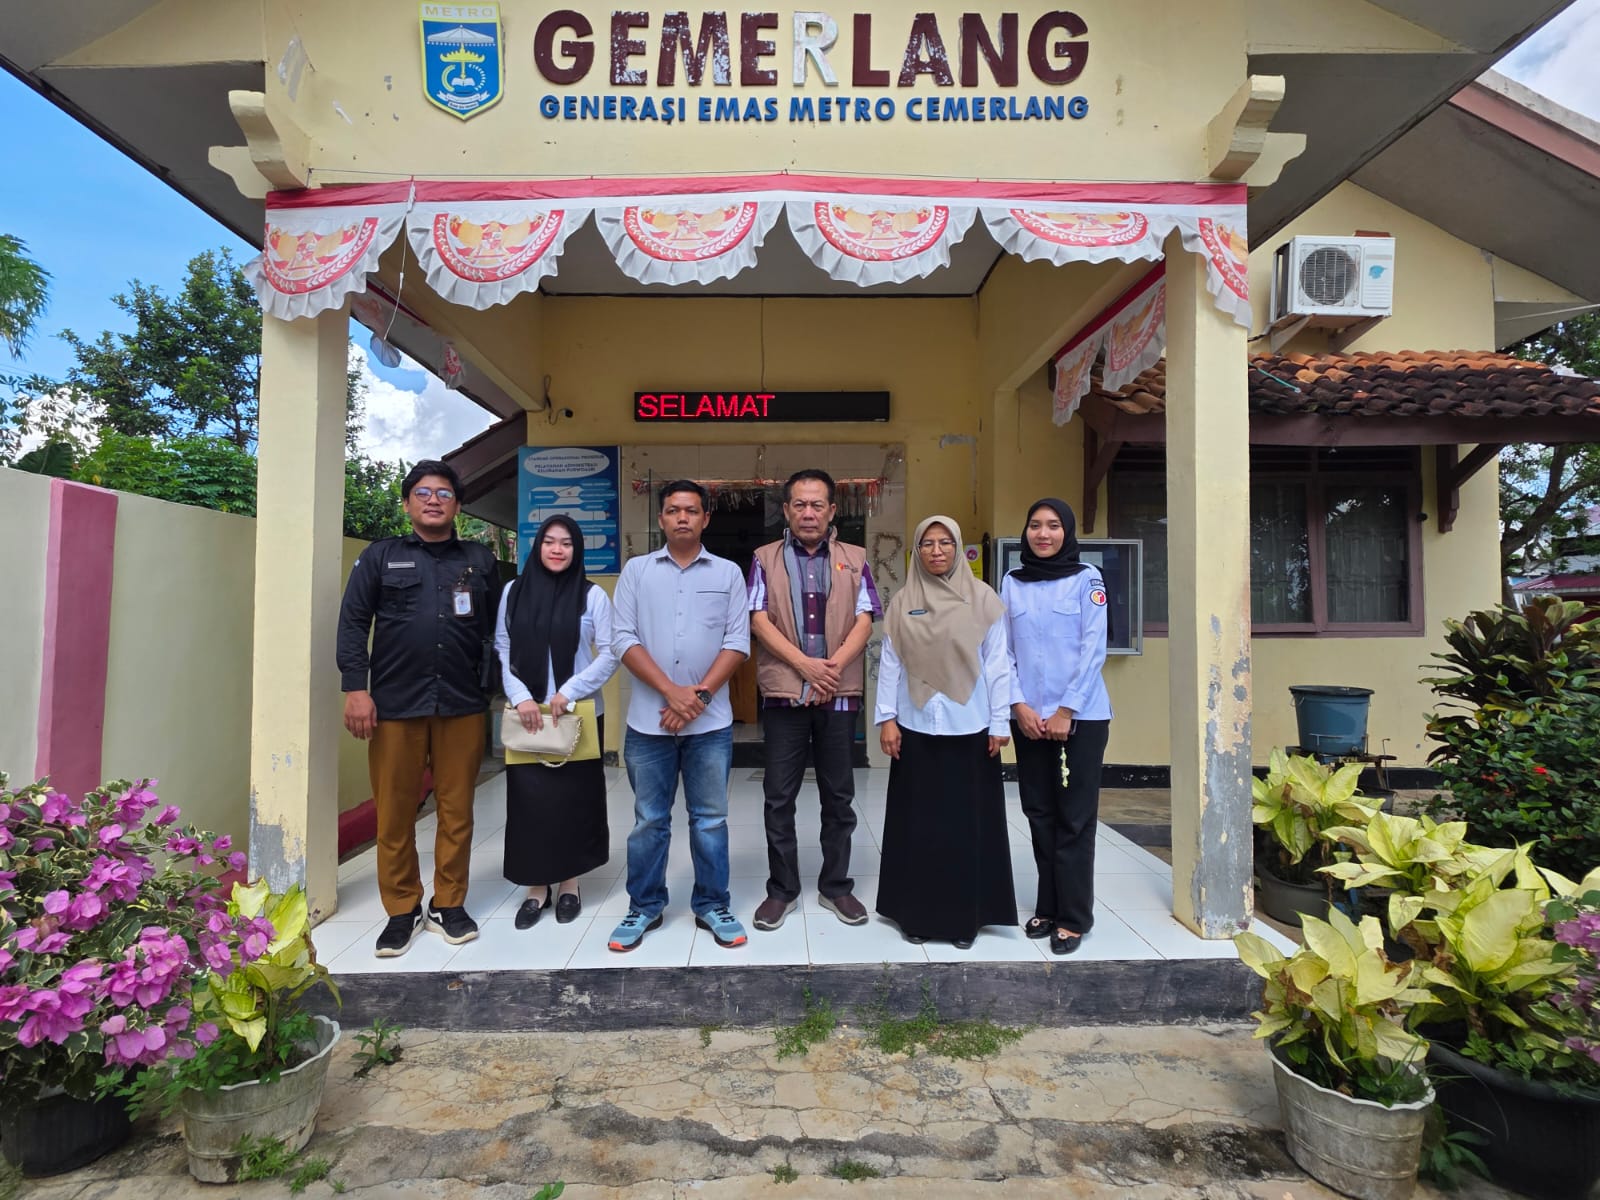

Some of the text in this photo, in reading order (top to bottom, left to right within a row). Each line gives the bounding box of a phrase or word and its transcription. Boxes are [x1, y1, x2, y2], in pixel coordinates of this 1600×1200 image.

[424, 6, 494, 17] METRO
[533, 9, 1089, 87] GEMERLANG
[539, 95, 1089, 120] GENERASI EMAS METRO CEMERLANG
[638, 394, 776, 417] SELAMAT
